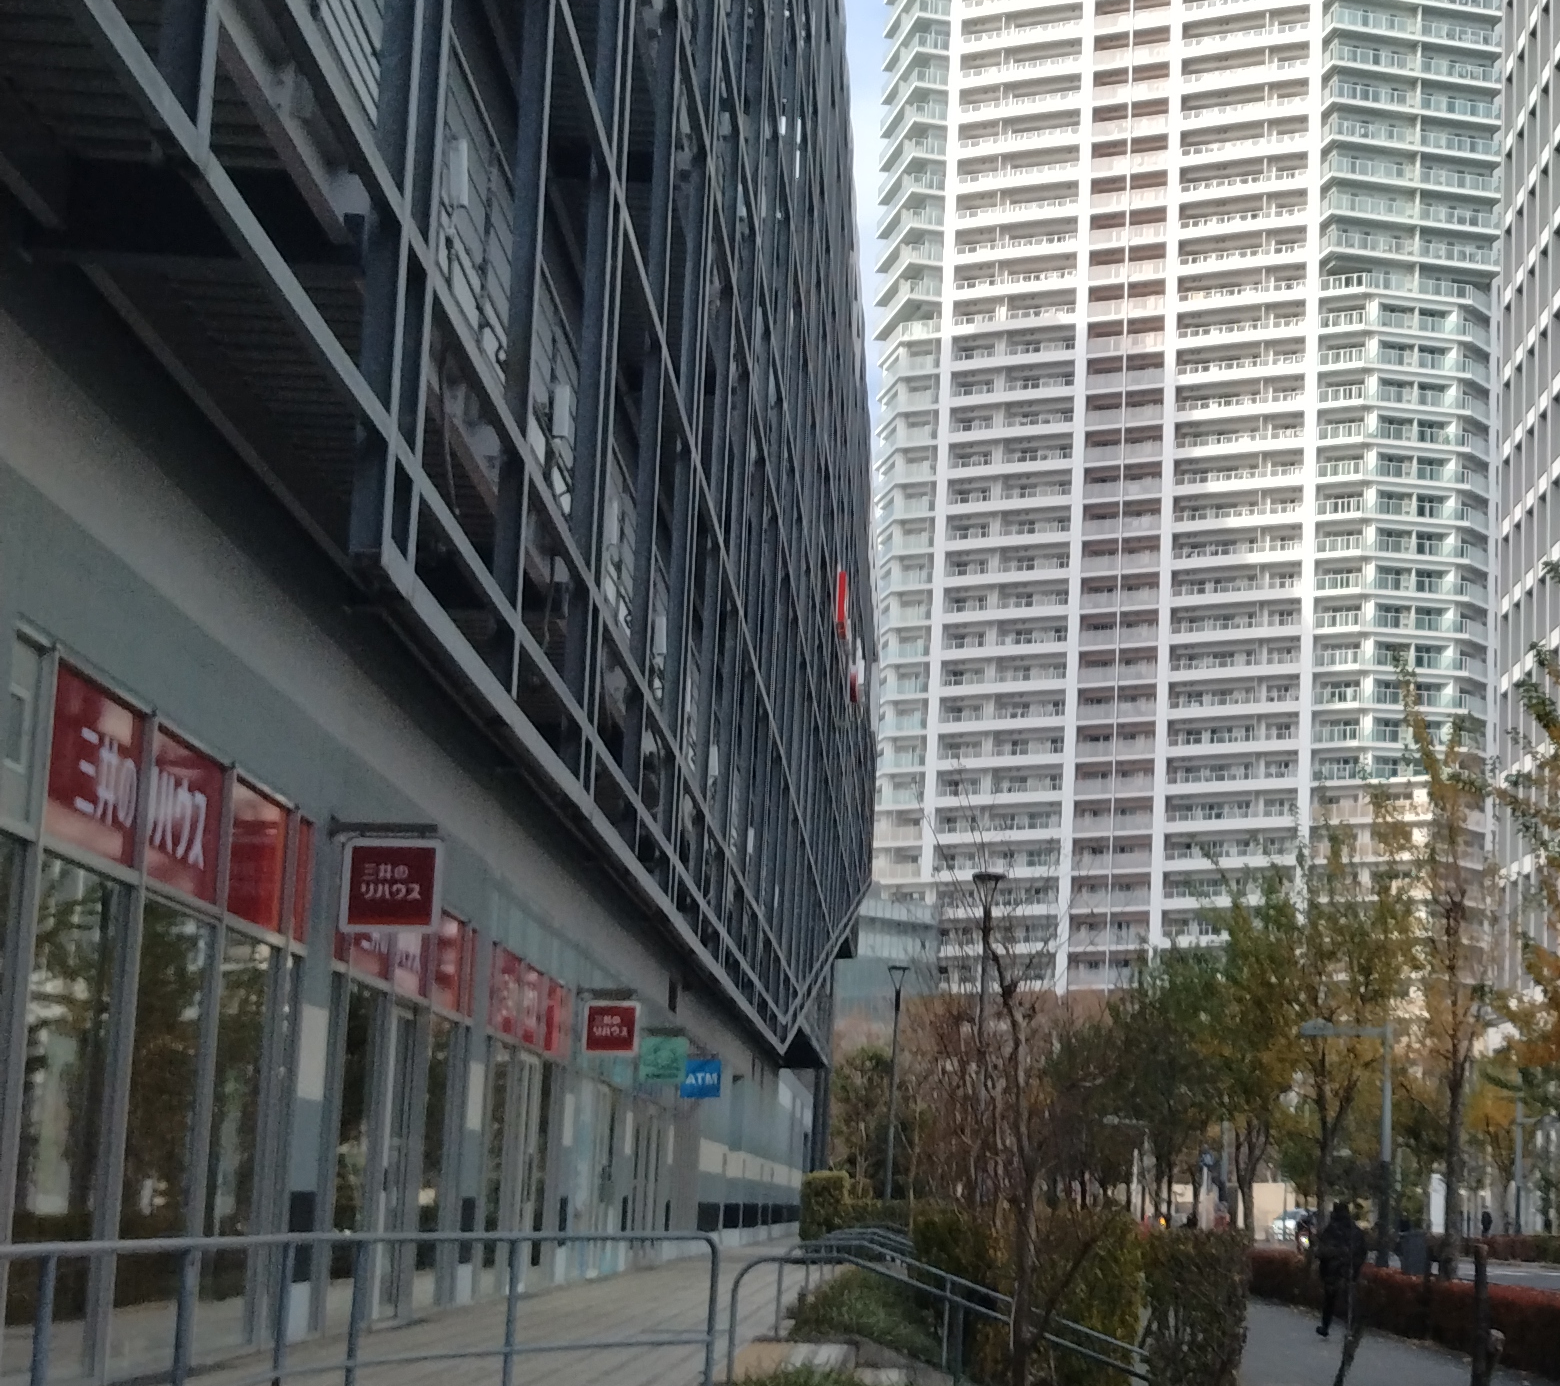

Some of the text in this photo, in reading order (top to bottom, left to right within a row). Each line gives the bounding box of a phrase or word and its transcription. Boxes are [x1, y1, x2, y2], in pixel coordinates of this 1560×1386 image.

[361, 863, 409, 880] 三井の
[360, 882, 421, 900] リハウス
[685, 1072, 718, 1085] ATM
